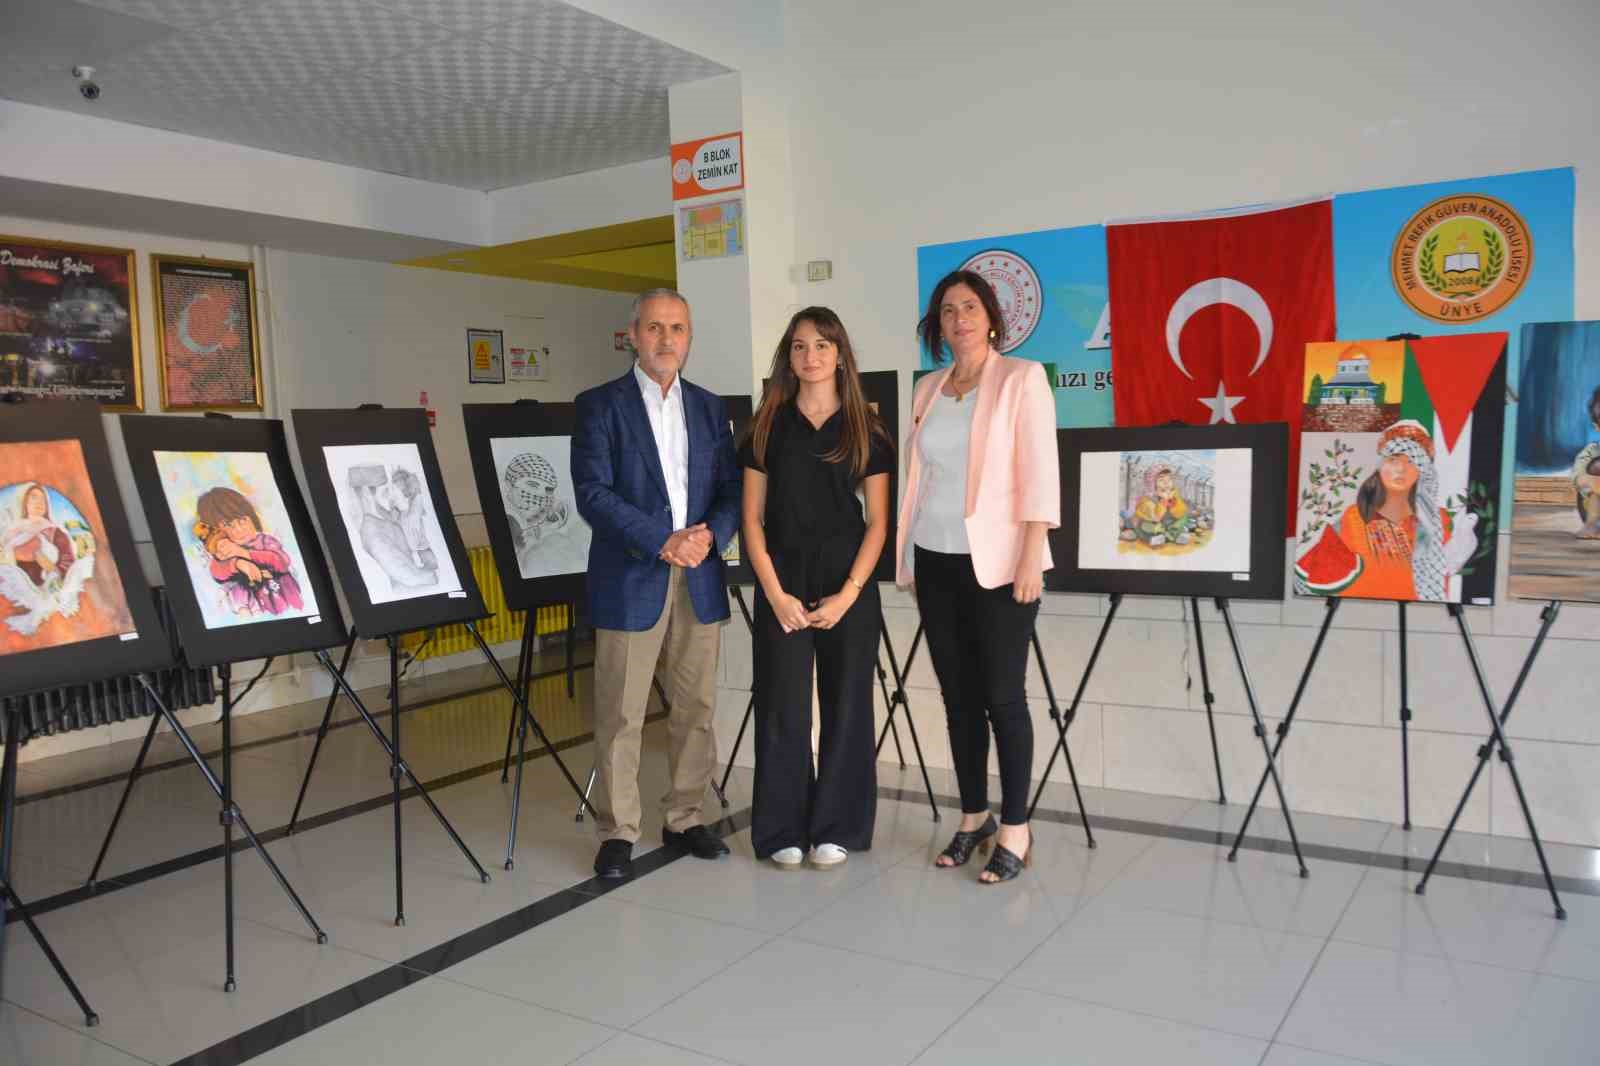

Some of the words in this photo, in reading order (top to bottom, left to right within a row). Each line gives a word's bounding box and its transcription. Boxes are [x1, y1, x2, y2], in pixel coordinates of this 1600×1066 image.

[703, 151, 709, 163] B
[710, 148, 731, 161] BLOK
[723, 162, 738, 177] KAT
[1401, 245, 1416, 290] MEHMET
[1479, 205, 1522, 247] ANADOLU
